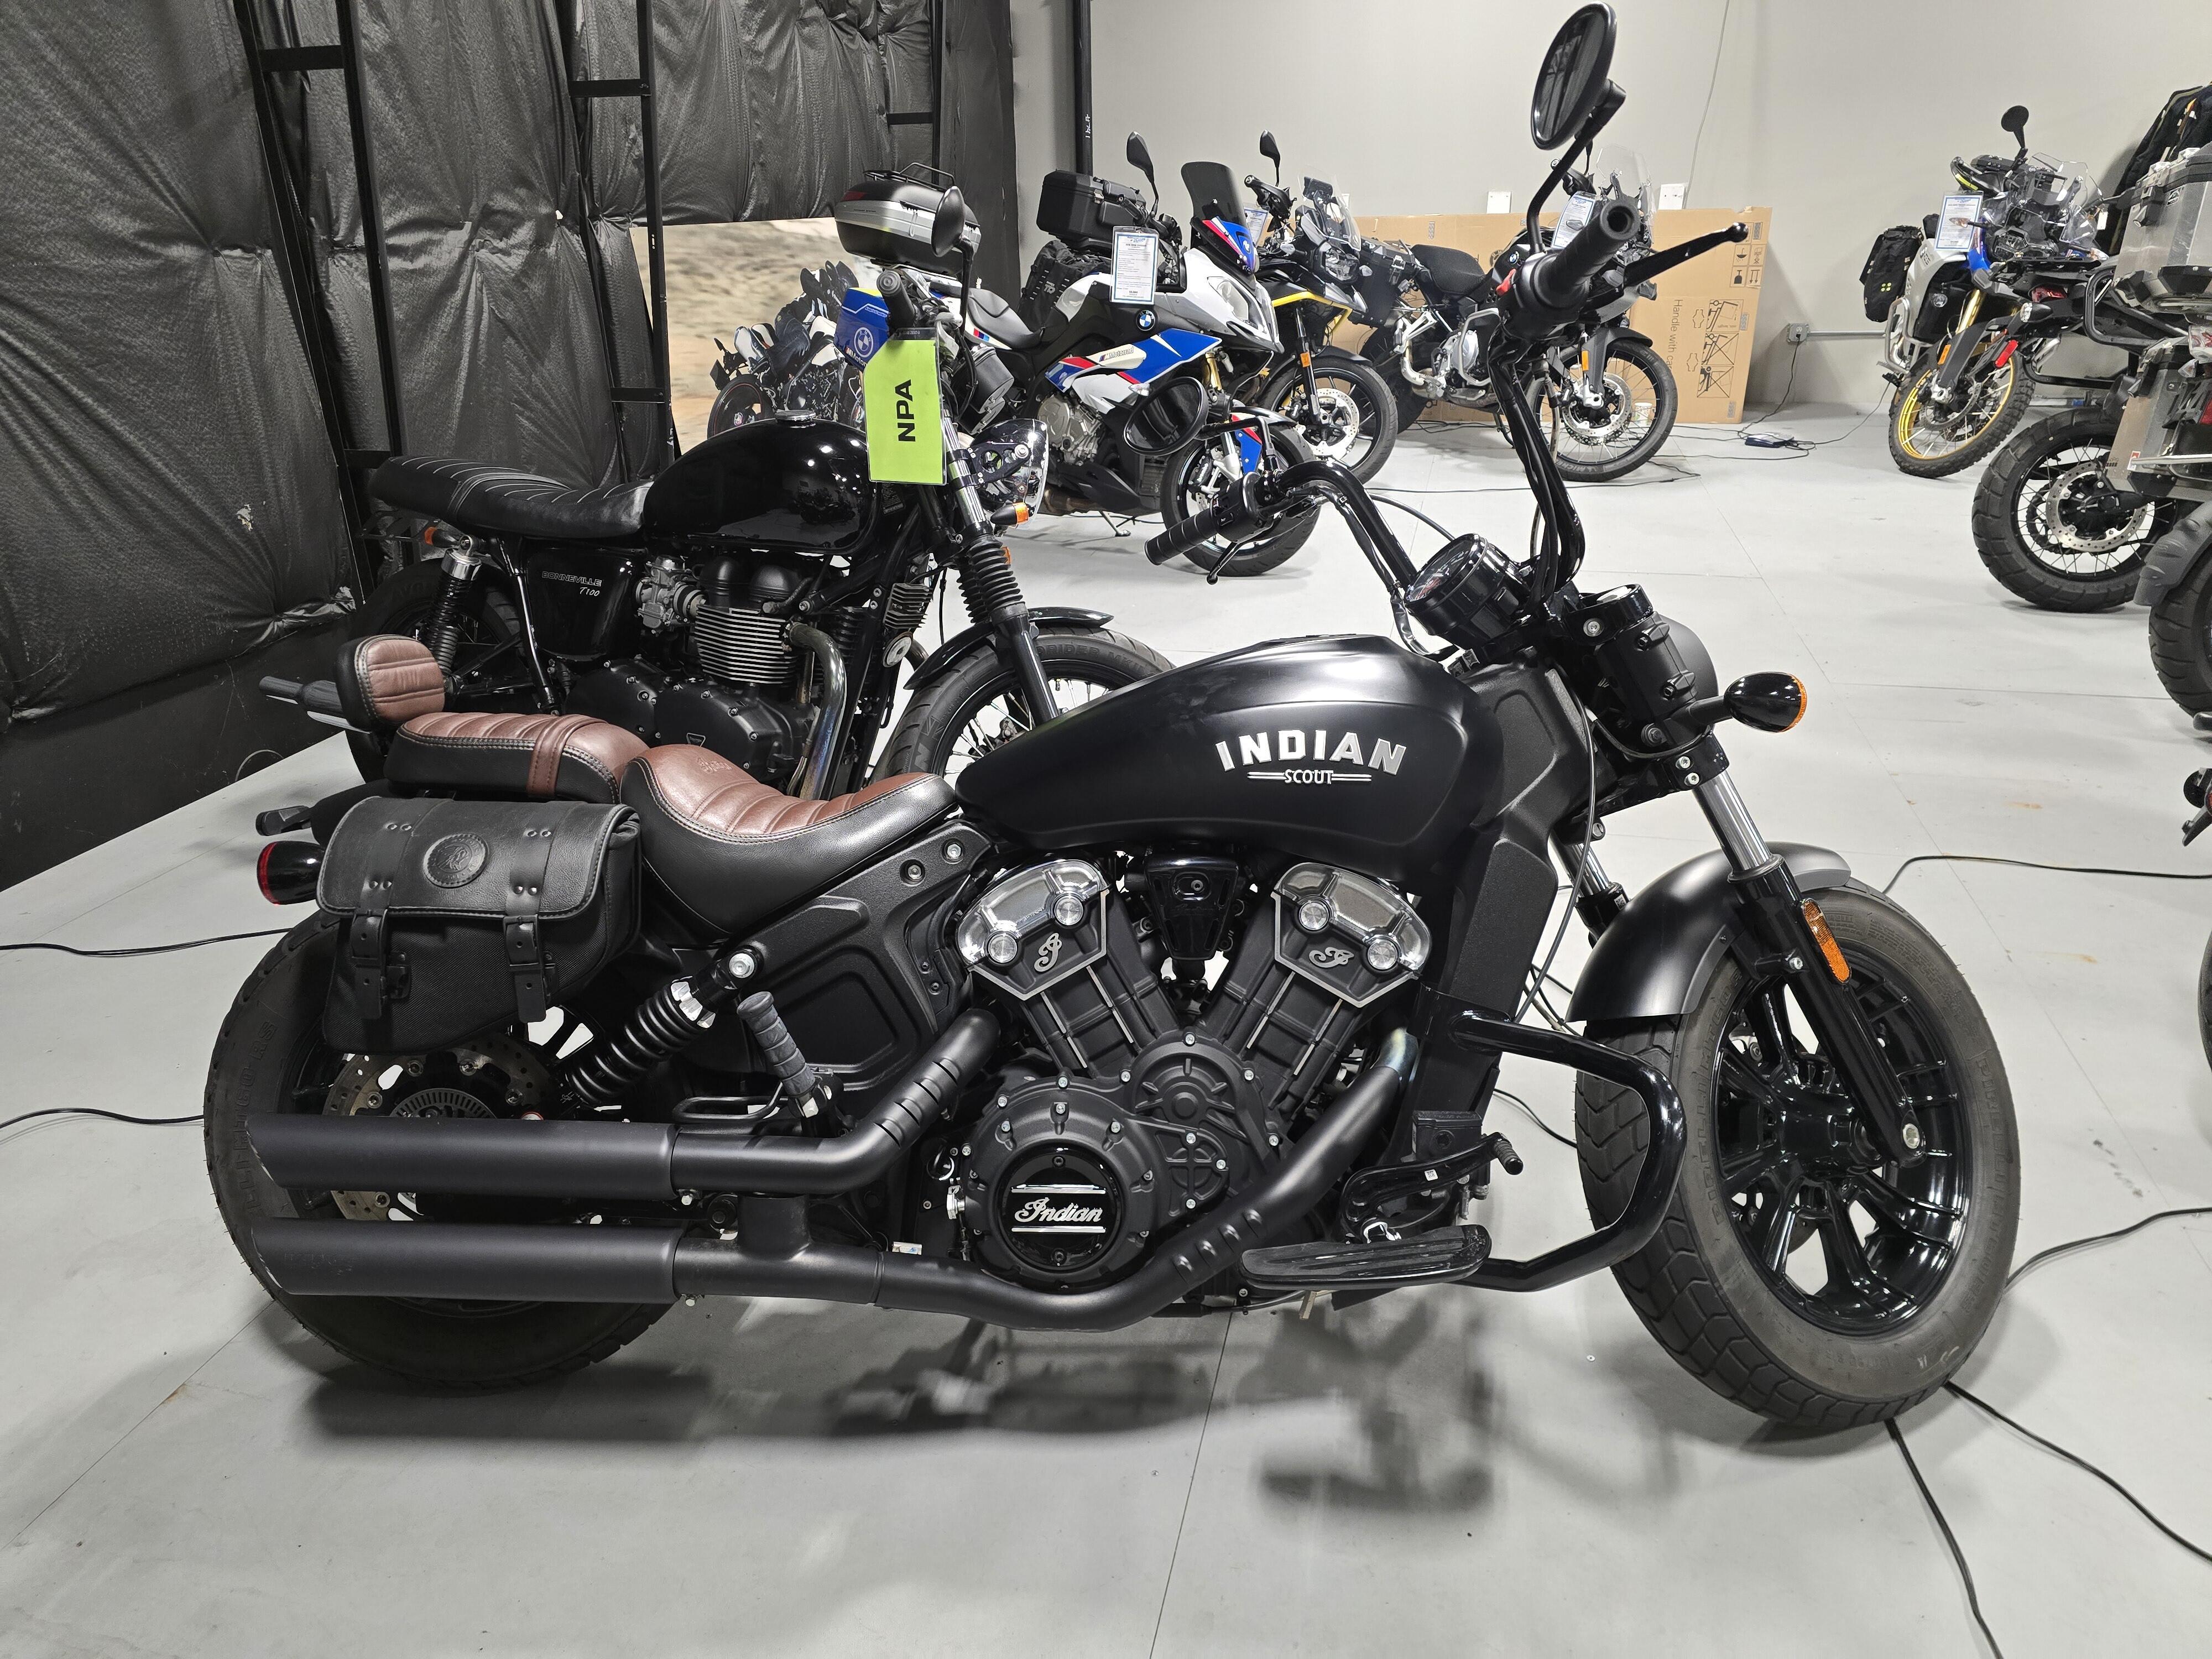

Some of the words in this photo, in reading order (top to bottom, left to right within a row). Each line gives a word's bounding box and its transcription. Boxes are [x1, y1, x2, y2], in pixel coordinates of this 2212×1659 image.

[1671, 299, 1683, 332] Handle
[1668, 335, 1677, 353] with
[851, 352, 867, 367] Motor
[894, 379, 916, 442] NPA
[541, 571, 602, 587] BONNEVILLE
[579, 586, 601, 597] T100
[1036, 644, 1100, 658] DRIDER
[1215, 729, 1407, 775] INDIAN
[1284, 769, 1334, 785] SCOUT
[1014, 1198, 1103, 1223] Indian
